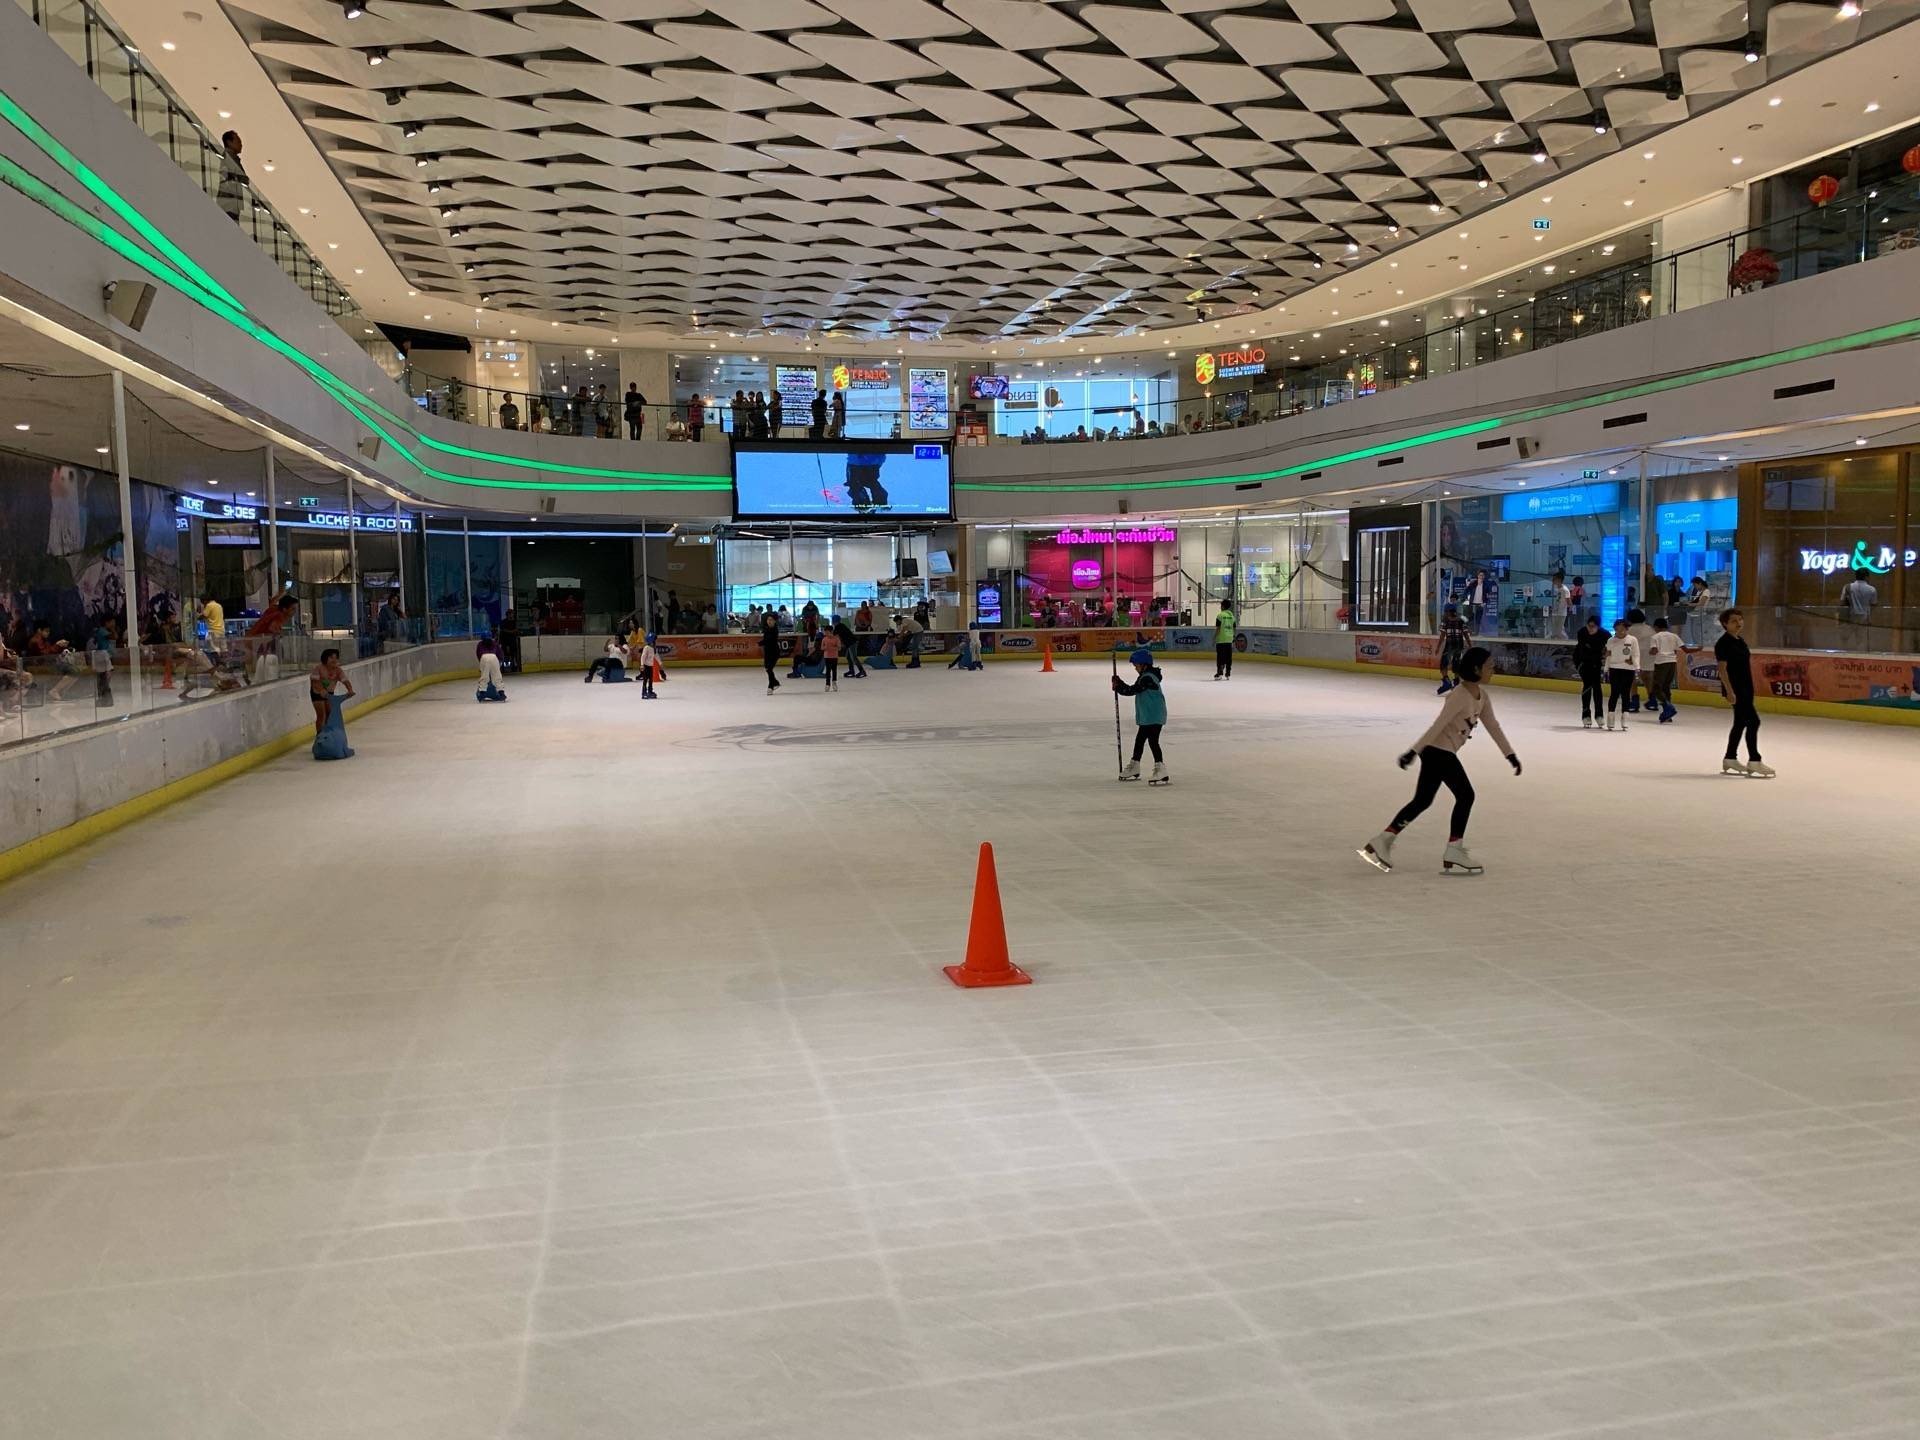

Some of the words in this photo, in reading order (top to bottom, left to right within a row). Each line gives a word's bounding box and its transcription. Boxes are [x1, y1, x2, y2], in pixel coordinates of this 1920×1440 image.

[1218, 348, 1266, 367] TENJO
[181, 495, 204, 512] TICKET
[223, 504, 256, 519] SHOES
[308, 513, 361, 526] LOCKER
[366, 517, 412, 529] ROOM
[1801, 550, 1850, 575] Yoga
[1851, 541, 1890, 574] &
[1775, 681, 1802, 696] 399
